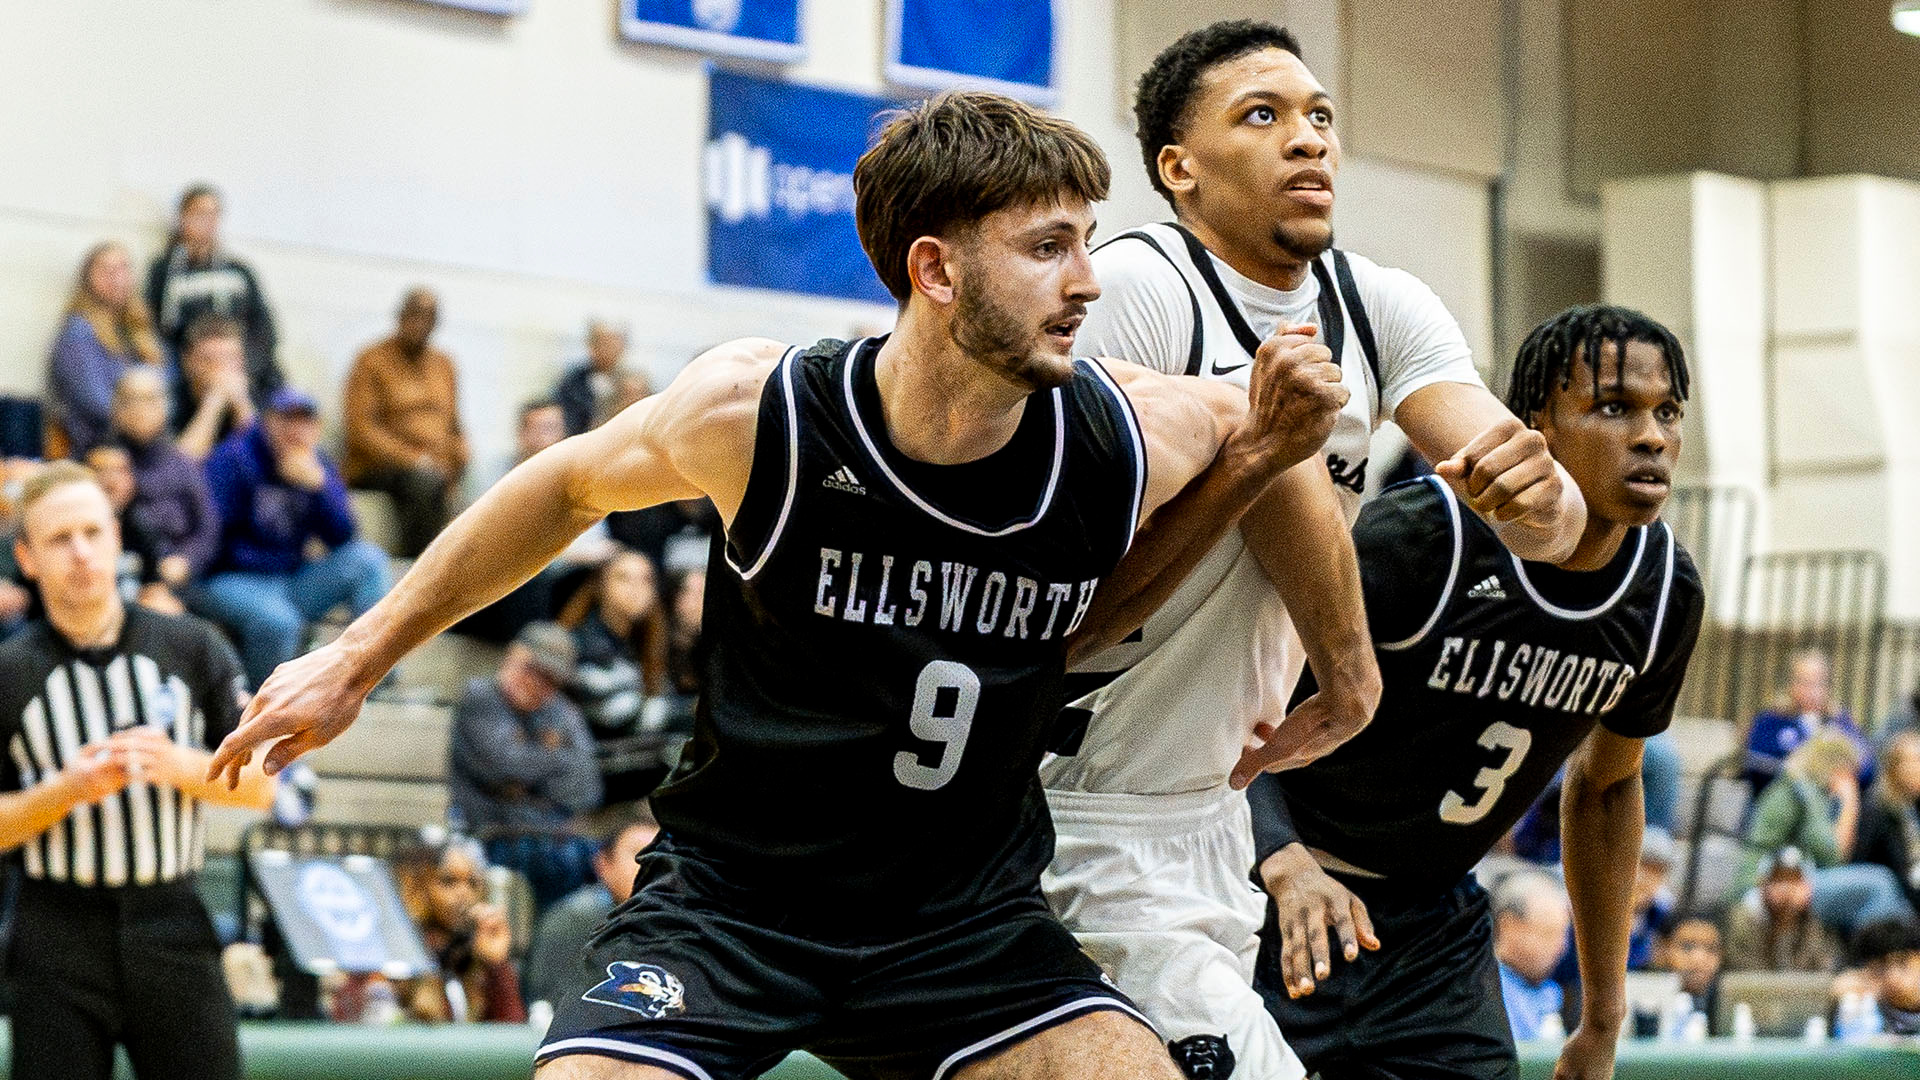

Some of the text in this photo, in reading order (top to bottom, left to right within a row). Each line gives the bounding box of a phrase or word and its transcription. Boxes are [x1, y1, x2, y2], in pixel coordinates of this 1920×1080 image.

[822, 479, 866, 496] adidas
[814, 547, 1099, 640] ELLSWORTH
[893, 659, 981, 791] 9
[1438, 719, 1532, 825] 3
